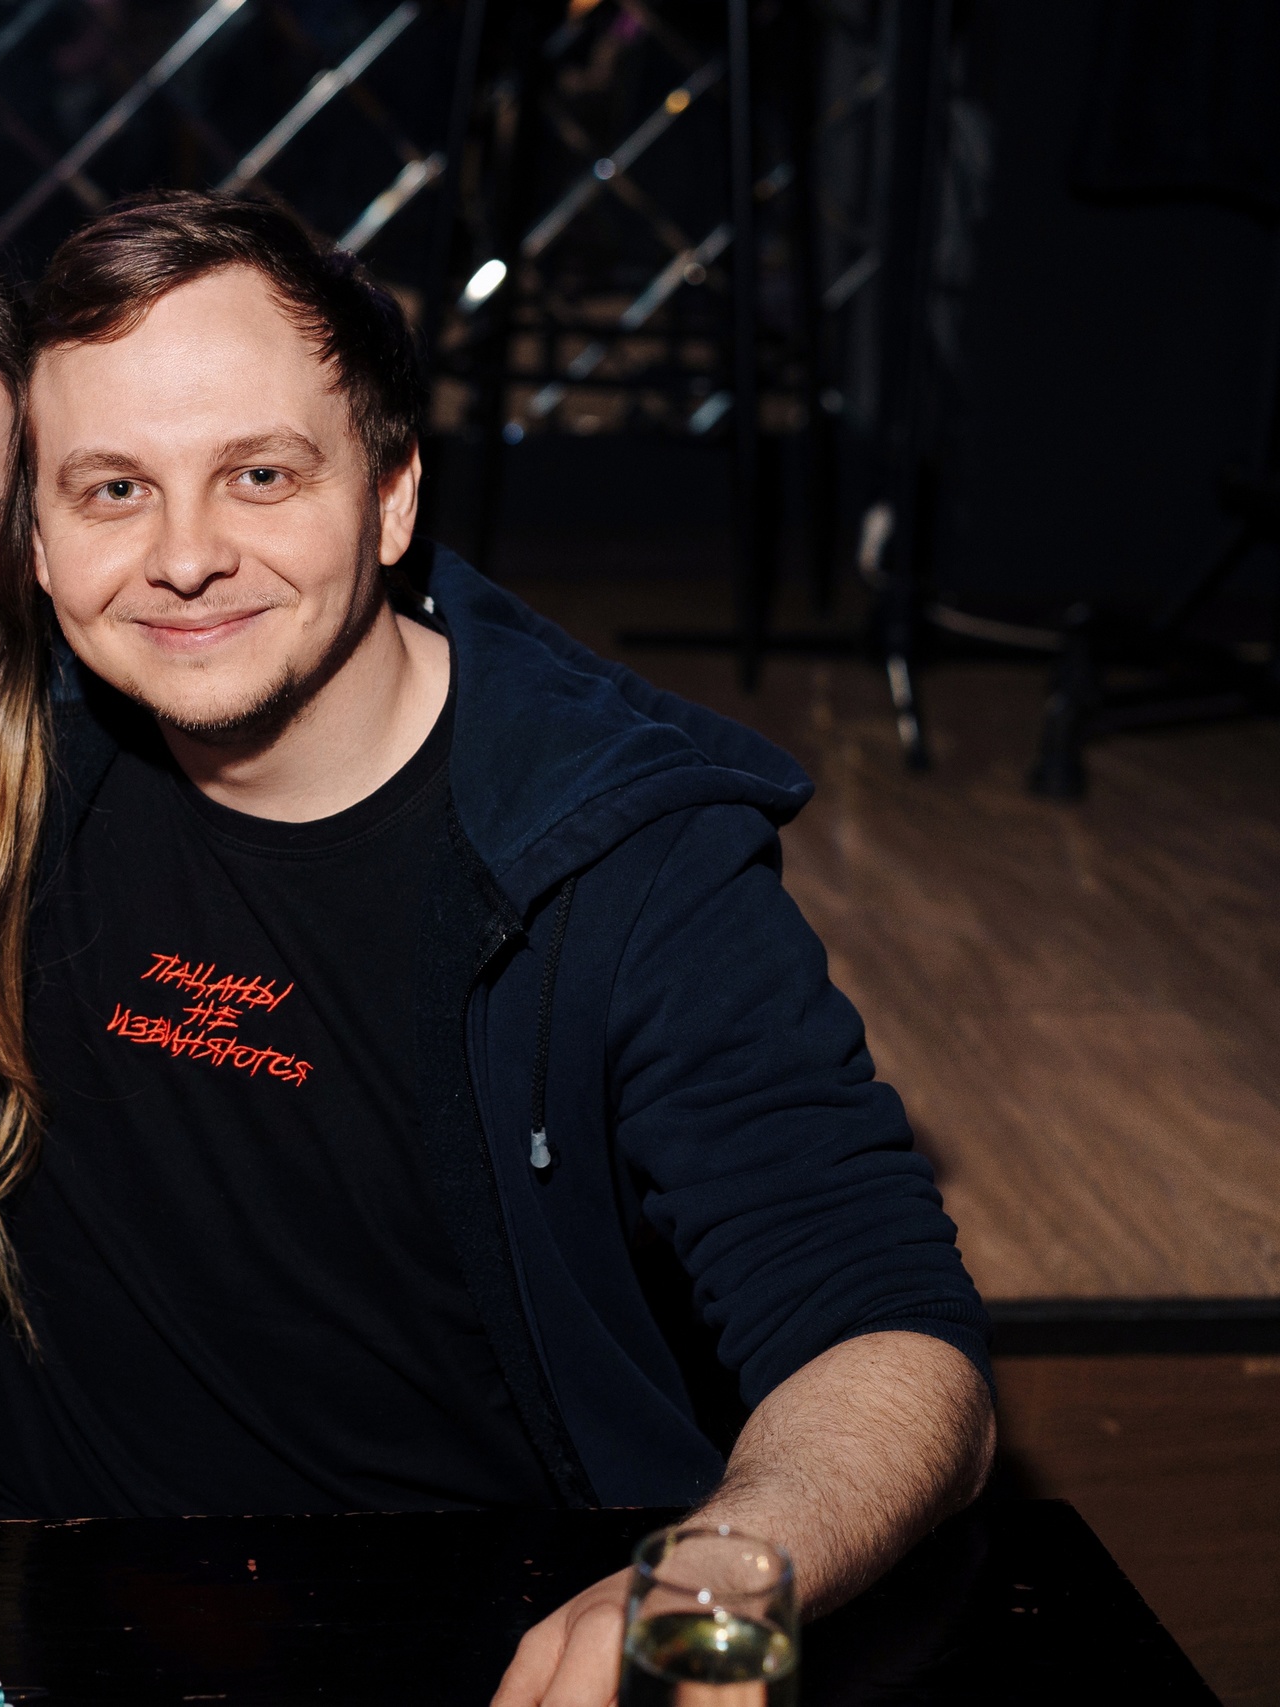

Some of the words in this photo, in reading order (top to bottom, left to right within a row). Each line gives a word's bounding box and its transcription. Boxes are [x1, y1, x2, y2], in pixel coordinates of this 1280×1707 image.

[141, 953, 294, 1012] ПАЦАНЫ
[107, 1003, 314, 1087] ИЗВИНЯЮТСЯ
[183, 1000, 243, 1032] НЕ
